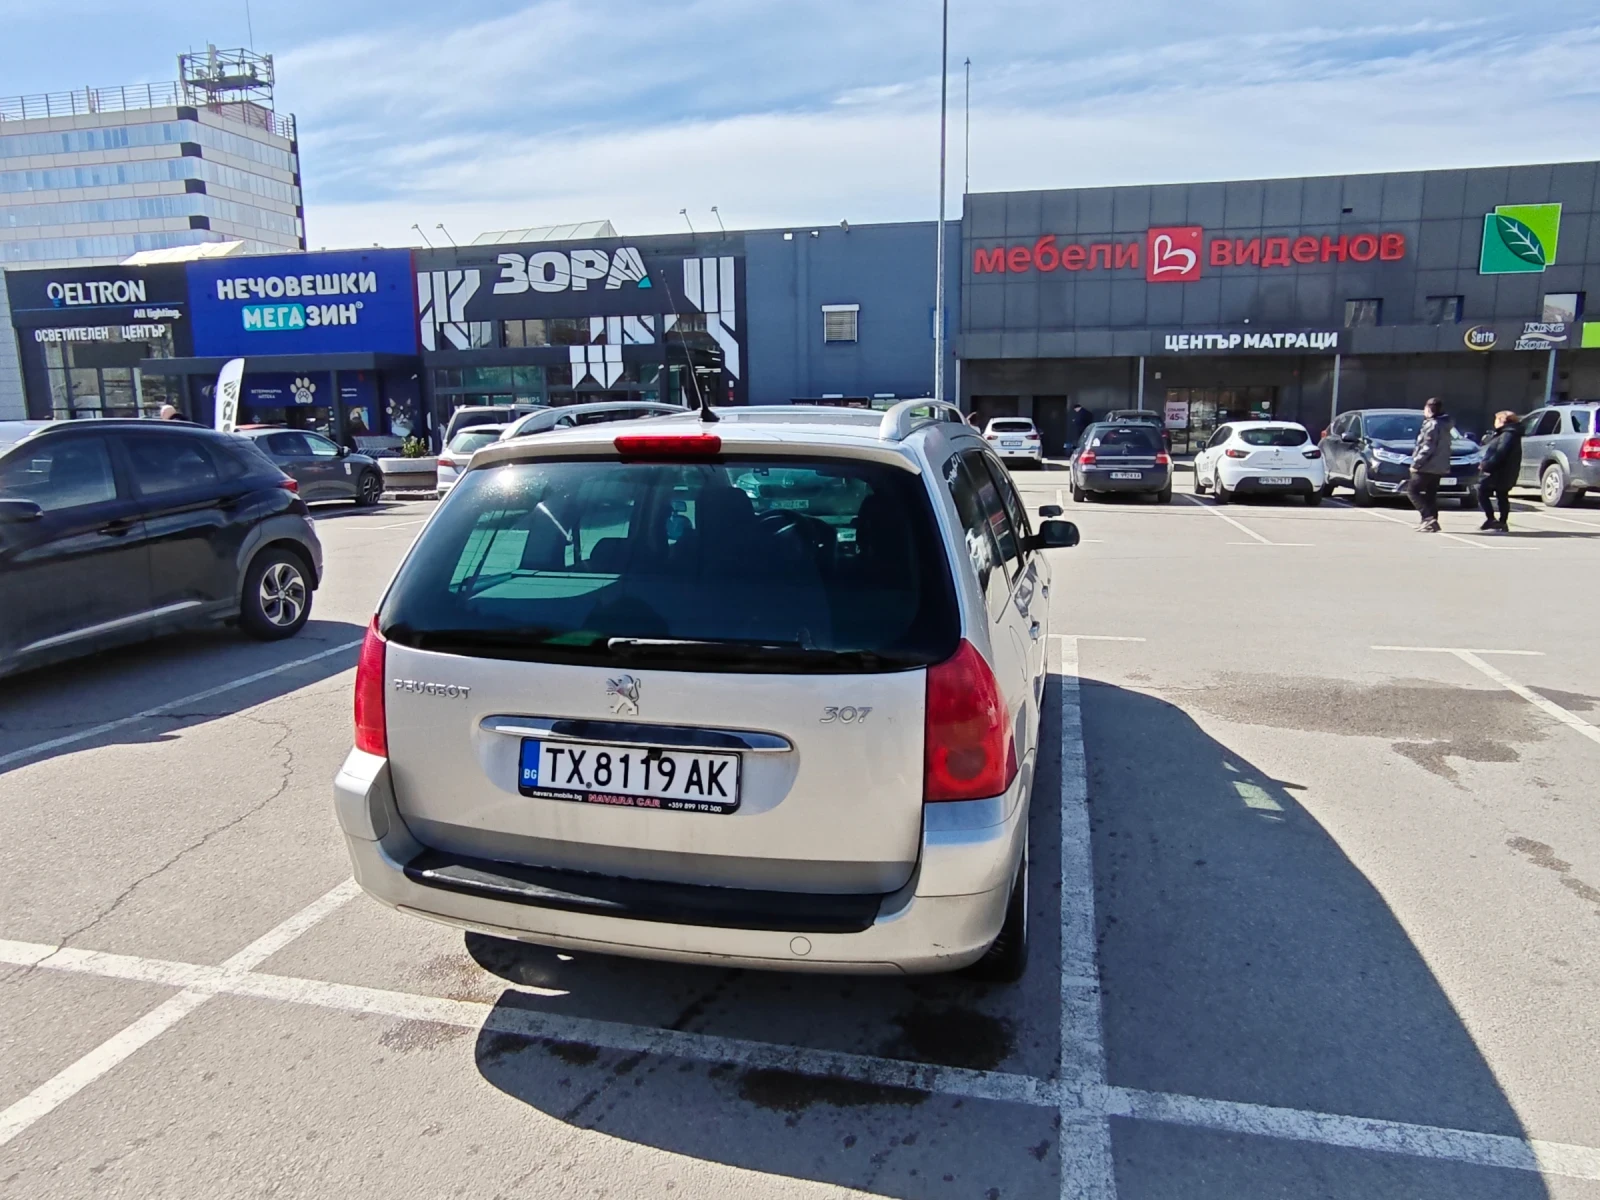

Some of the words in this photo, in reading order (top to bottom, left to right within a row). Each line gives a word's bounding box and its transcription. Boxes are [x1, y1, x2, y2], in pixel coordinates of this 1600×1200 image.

[973, 234, 1140, 274] мебели
[1209, 232, 1407, 268] виденов
[493, 247, 651, 295] ЗОРА
[216, 271, 377, 300] НЕЧОВЕШКИ
[133, 308, 146, 318] All
[34, 326, 109, 342] ОСВЕТИТЕЛЕН
[121, 324, 166, 340] ЦЕНТЪР
[1523, 322, 1565, 333] KING
[1164, 333, 1242, 351] ЦЕНТЪР
[1243, 331, 1338, 350] МАТРАЦИ
[1470, 330, 1495, 344] Serta
[1514, 340, 1552, 350] KOIL
[393, 678, 471, 699] PEUGEOT
[819, 706, 873, 724] 307
[524, 769, 537, 780] BG
[546, 748, 586, 785] TX
[593, 752, 676, 792] 8119
[683, 759, 729, 797] AK
[532, 790, 583, 802] navara.mobile.bg
[588, 793, 635, 805] NAVARA
[636, 796, 661, 808] CAR
[684, 802, 696, 810] 899
